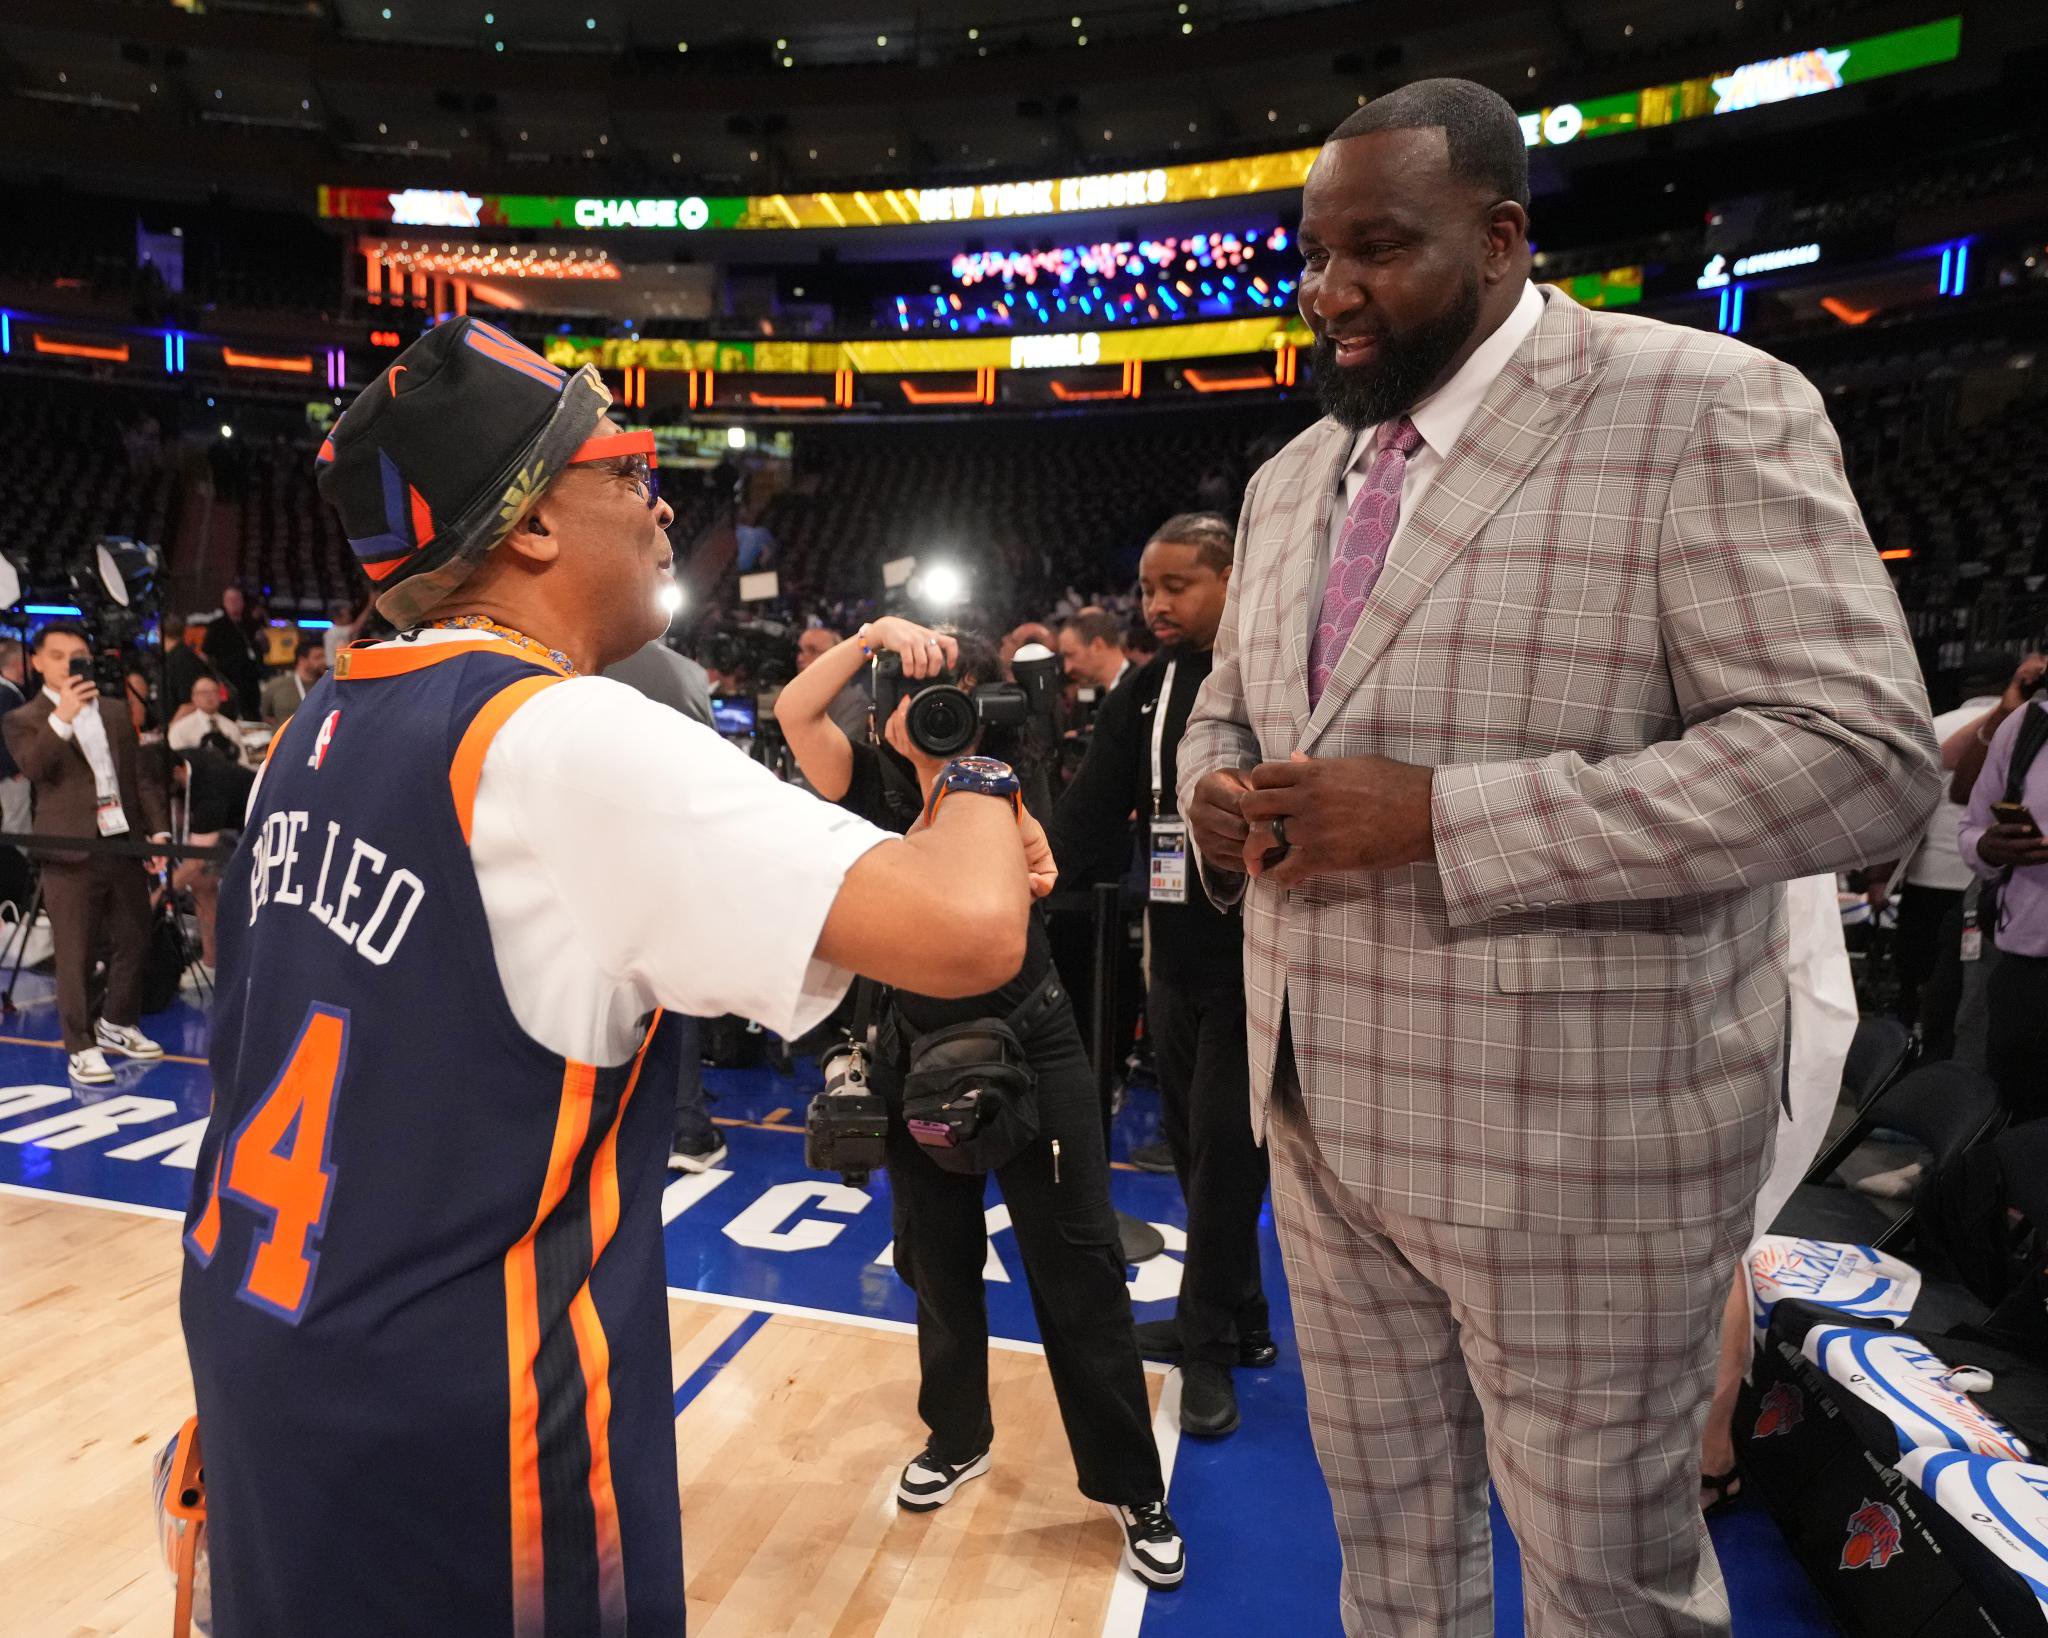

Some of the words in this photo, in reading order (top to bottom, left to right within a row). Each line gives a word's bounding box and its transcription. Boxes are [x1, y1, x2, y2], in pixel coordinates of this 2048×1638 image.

[574, 199, 678, 228] CHASE
[1010, 332, 1101, 369] FINALS
[249, 811, 309, 927] PPE
[308, 821, 425, 966] LEO
[182, 1000, 350, 1325] 4
